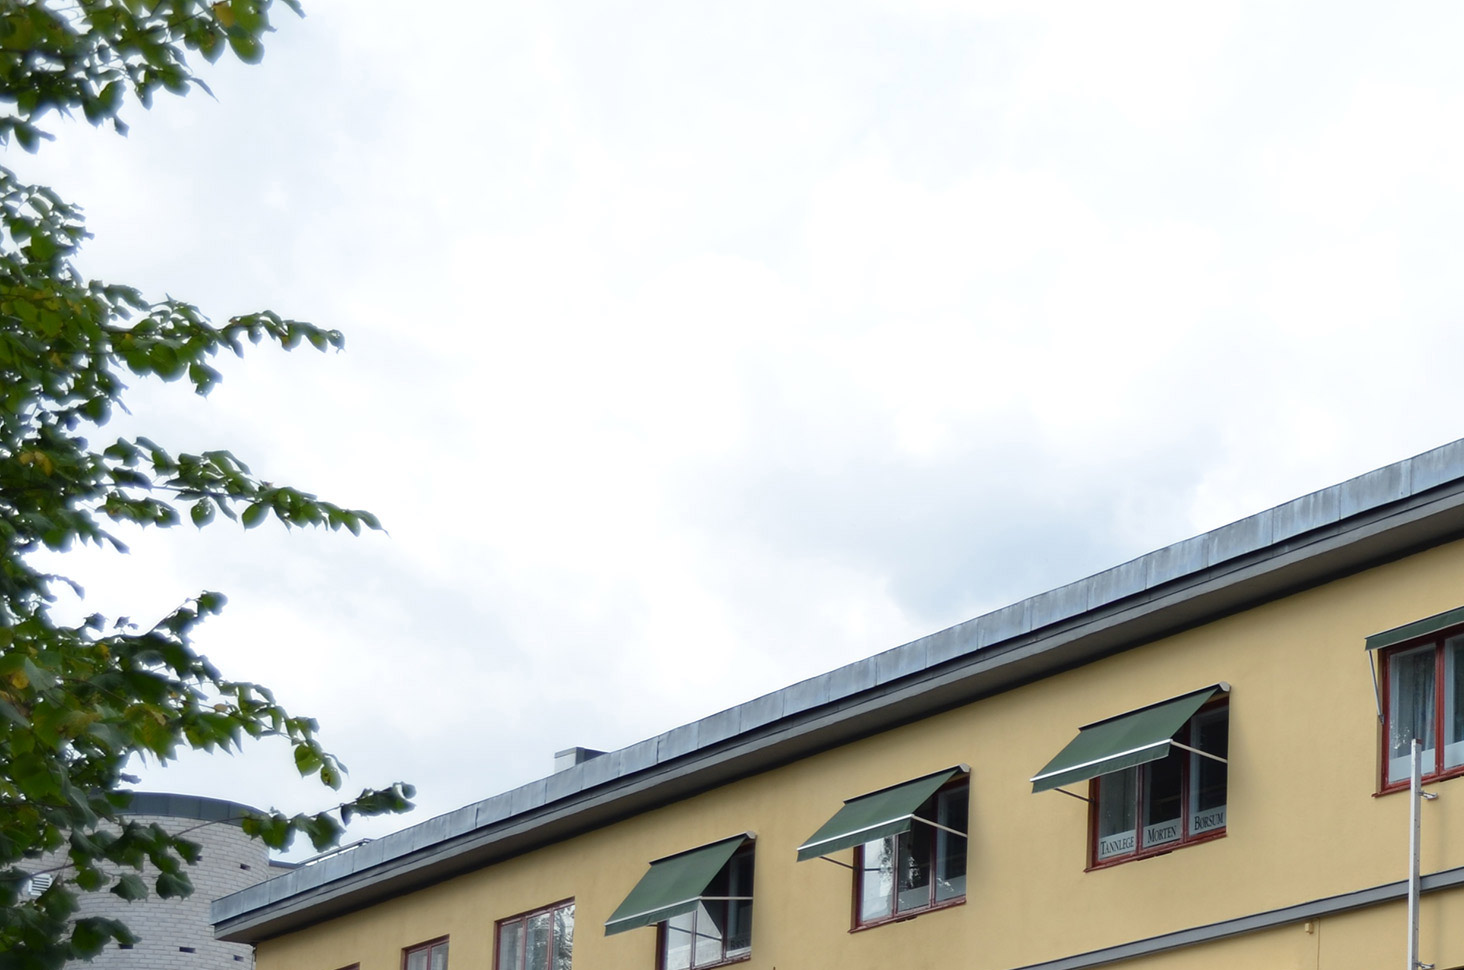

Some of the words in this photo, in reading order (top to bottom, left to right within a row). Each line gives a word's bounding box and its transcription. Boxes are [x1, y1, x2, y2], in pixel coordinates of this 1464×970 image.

[1100, 836, 1135, 856] TANNLEGE
[1147, 826, 1177, 844] MORTEN
[1194, 812, 1224, 831] BORSUM
